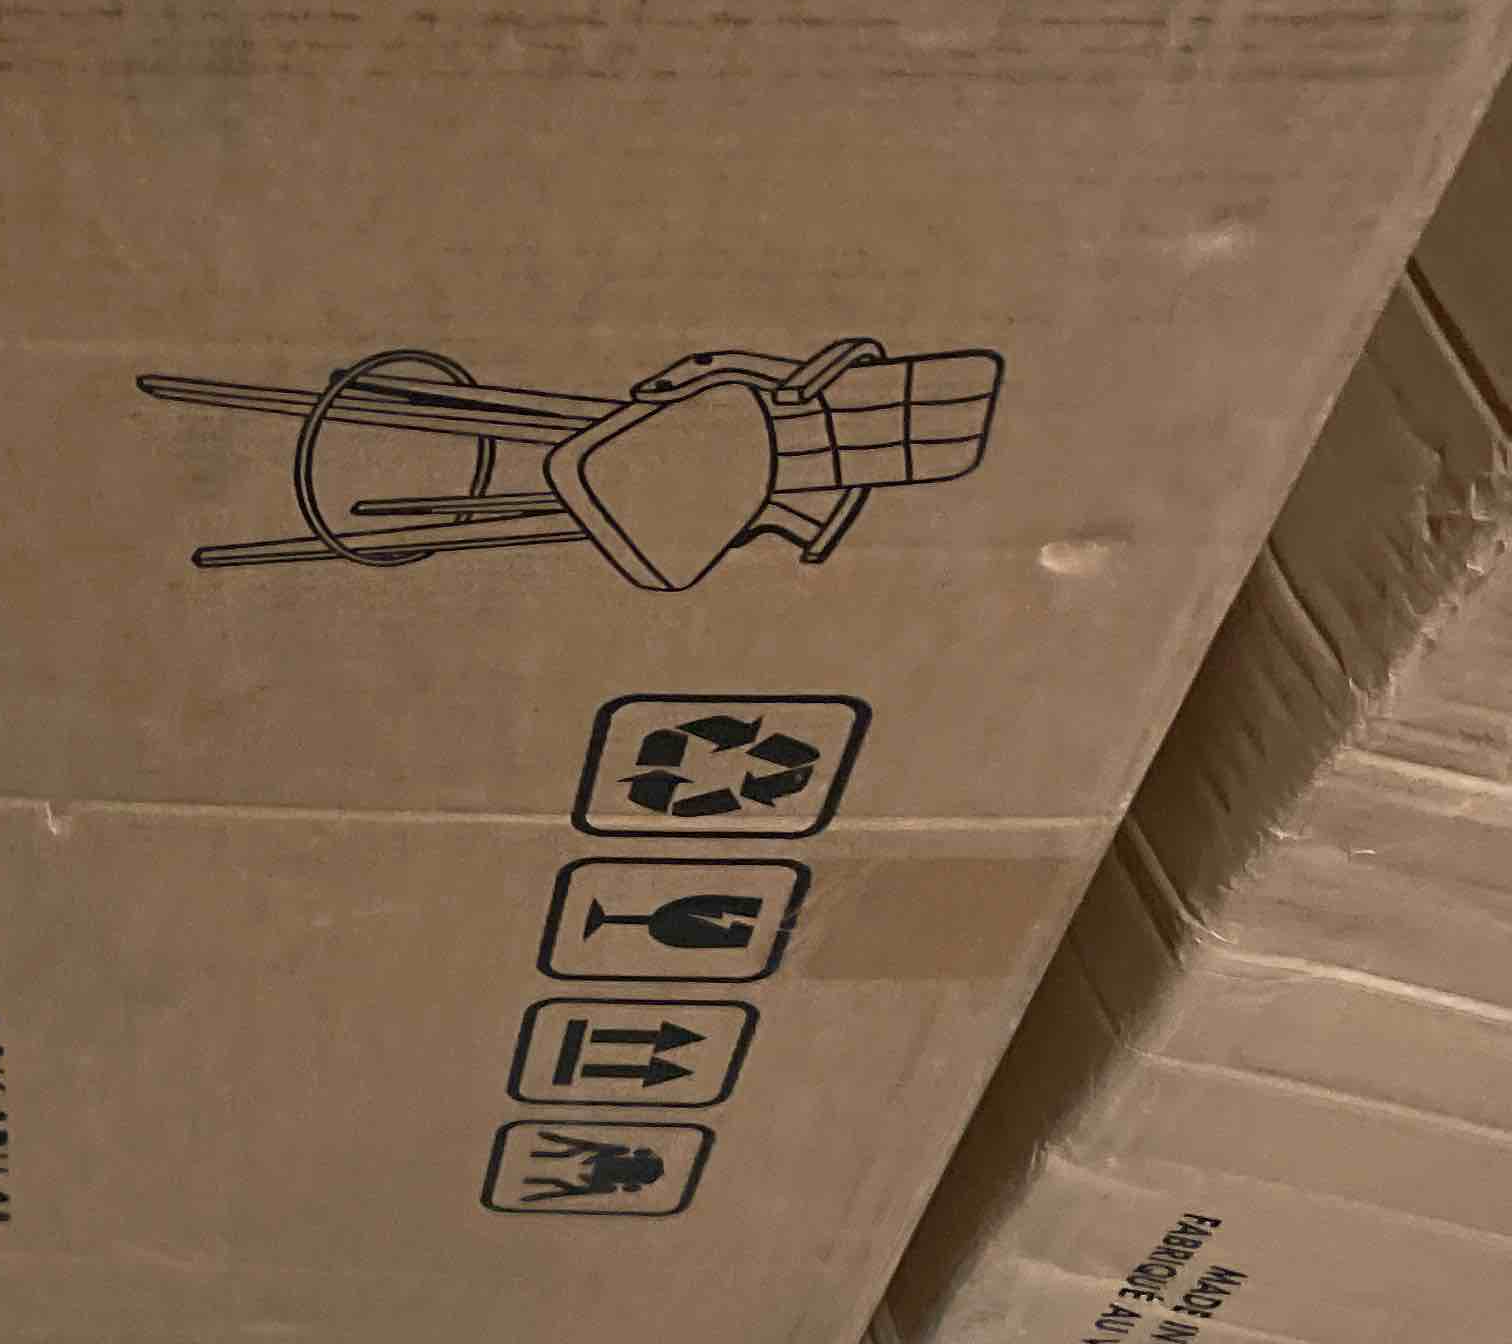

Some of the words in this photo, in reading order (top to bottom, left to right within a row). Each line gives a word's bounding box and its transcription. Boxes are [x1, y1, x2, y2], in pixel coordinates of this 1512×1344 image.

[1171, 1265, 1248, 1319] MADE
[1095, 1304, 1142, 1334] AU
[1150, 1320, 1199, 1344] IN
